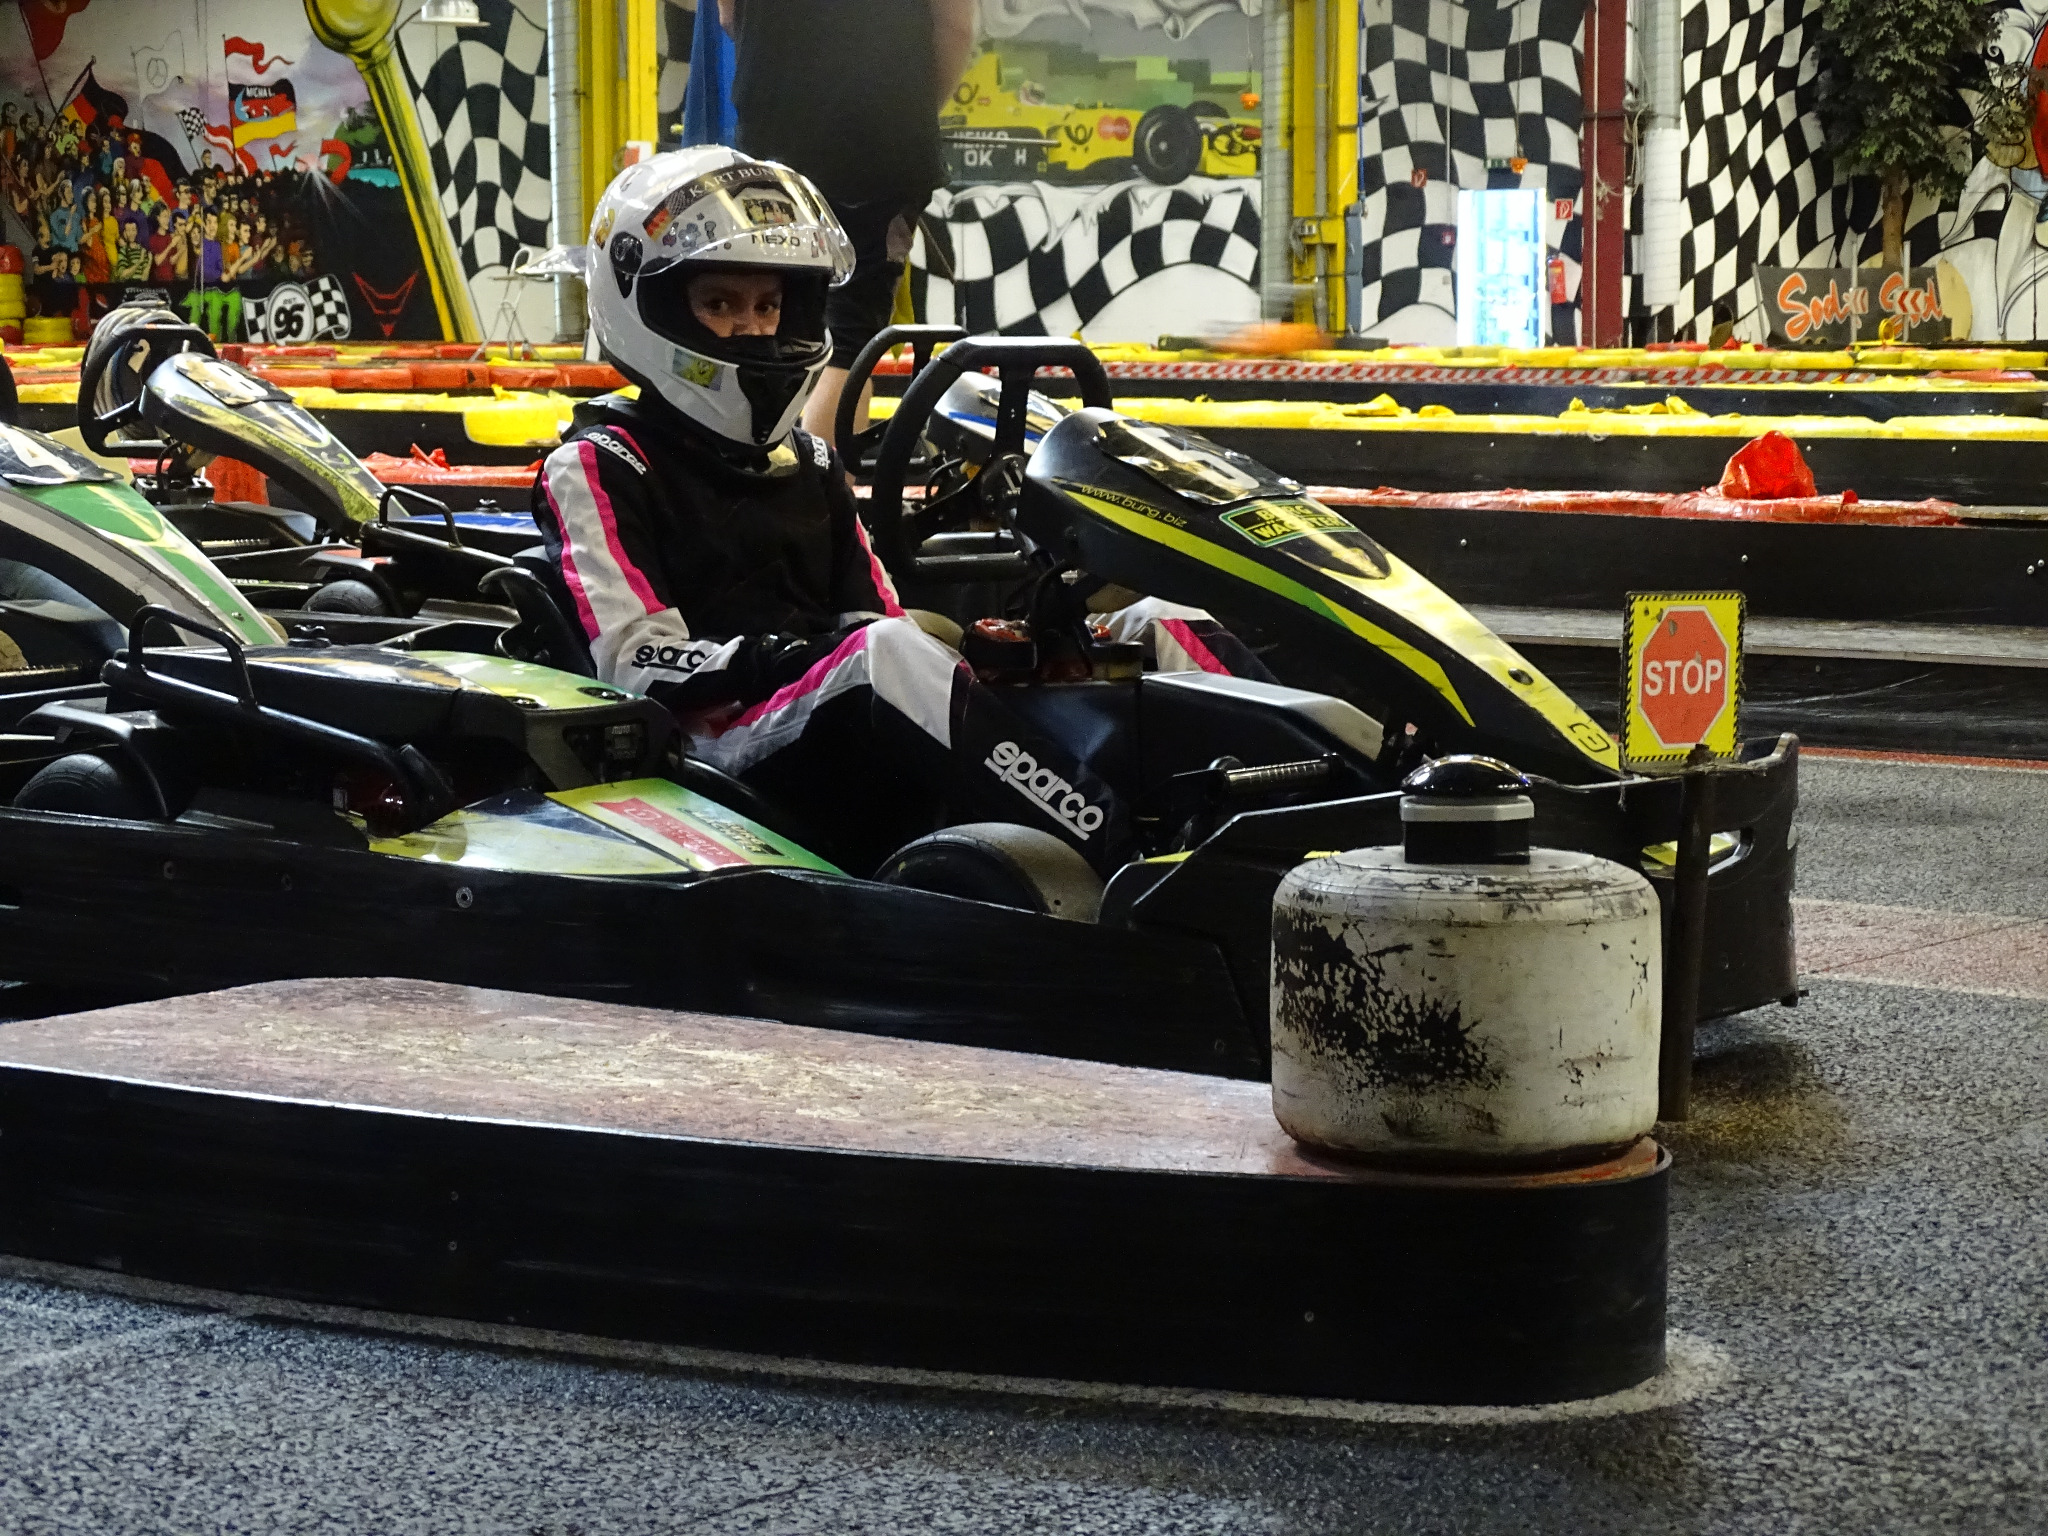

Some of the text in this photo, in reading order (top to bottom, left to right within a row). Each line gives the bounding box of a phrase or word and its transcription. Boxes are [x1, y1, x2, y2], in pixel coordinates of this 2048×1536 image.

[964, 148, 1026, 167] OK H
[689, 172, 734, 198] KART
[752, 234, 800, 248] NEXO
[274, 303, 305, 339] 96
[584, 432, 647, 475] sparco
[1081, 485, 1188, 528] www.burg.biz
[1644, 659, 1723, 696] STOP
[984, 741, 1104, 840] sparco
